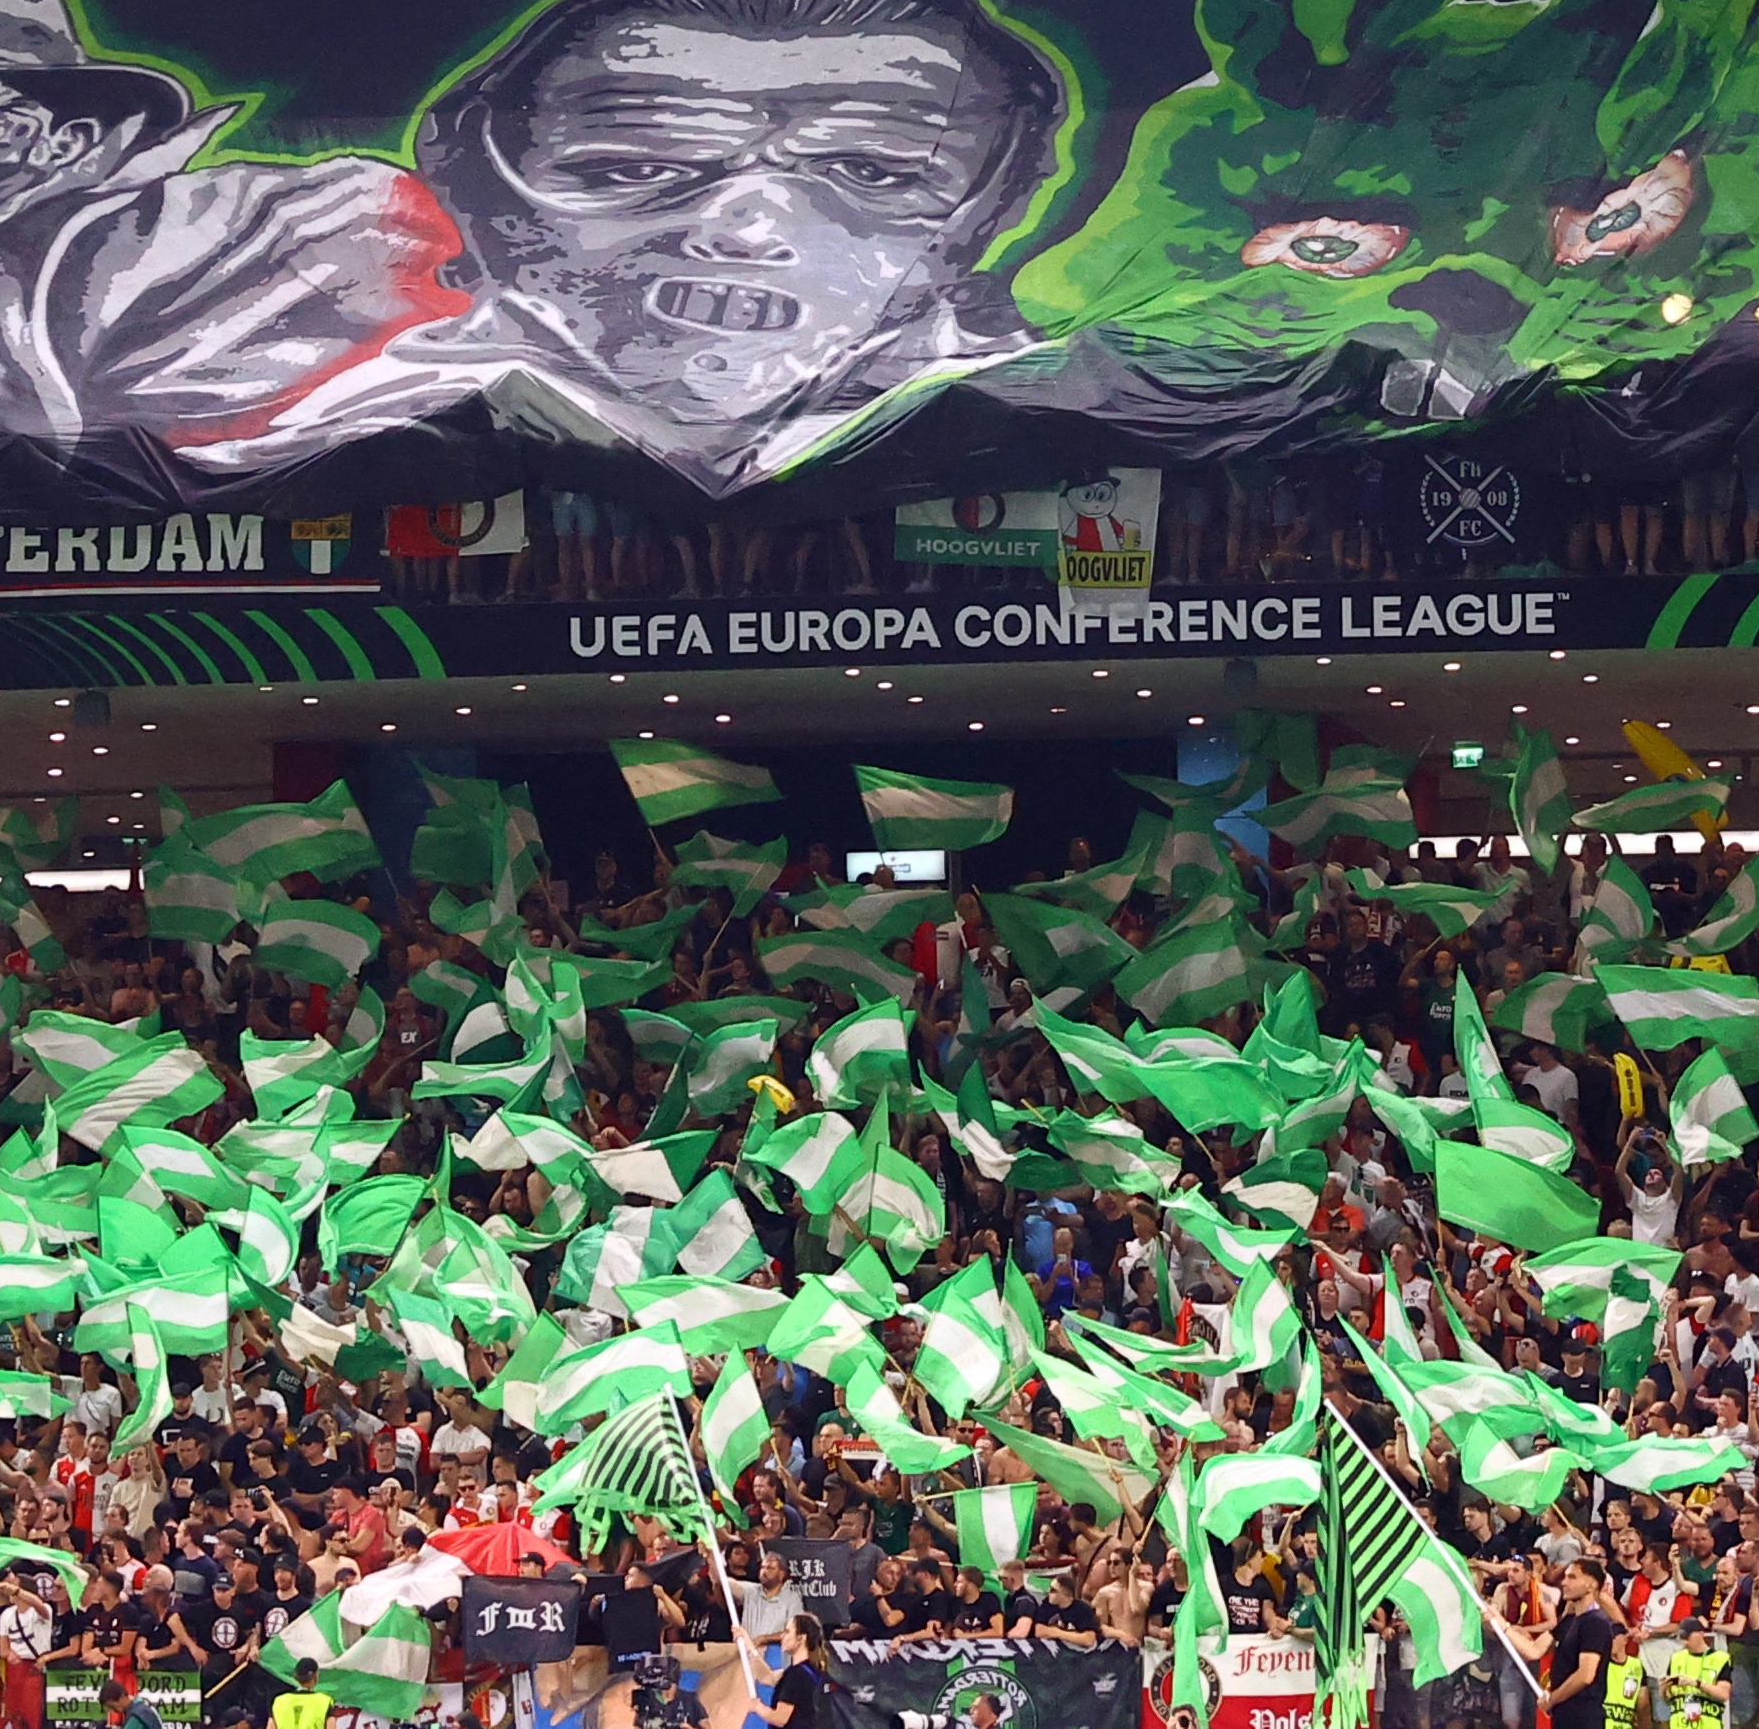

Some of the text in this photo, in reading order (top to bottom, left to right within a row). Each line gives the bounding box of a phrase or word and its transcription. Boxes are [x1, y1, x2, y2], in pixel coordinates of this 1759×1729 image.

[916, 537, 1041, 558] HOOGVLIET
[570, 613, 713, 659] UEFA
[728, 608, 942, 655] EUROPA
[954, 597, 1323, 649] CONFERENCE
[1235, 1646, 1317, 1678] Feyen
